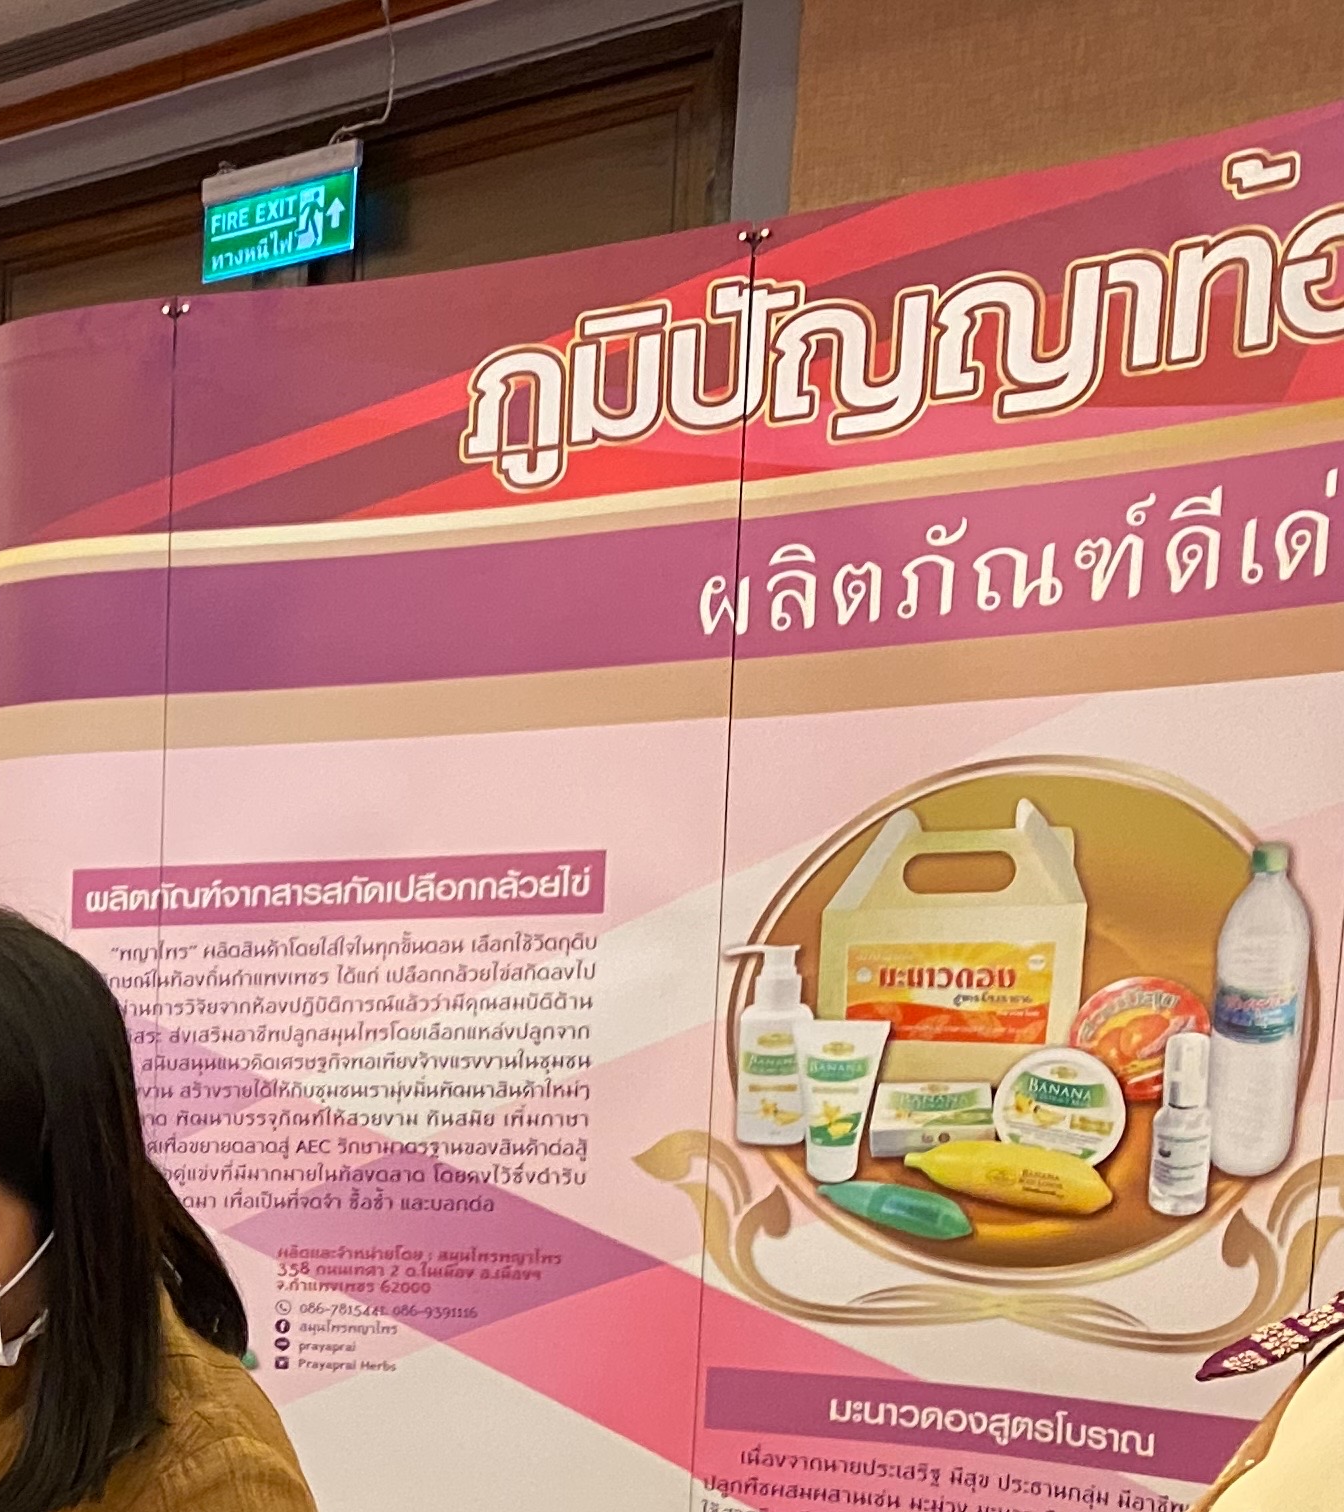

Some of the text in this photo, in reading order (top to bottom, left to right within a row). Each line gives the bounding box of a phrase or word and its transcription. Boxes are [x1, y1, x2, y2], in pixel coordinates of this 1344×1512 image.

[211, 194, 299, 235] FIRE EXIT
[211, 230, 294, 272] ทางหนีไฟ
[85, 863, 592, 913] ผลิตภัณฑ์จากสารสกัดเปลือกกล้วยไข่
[105, 964, 329, 989] กษณ์ในท้องถิ่นกำแพงเพชร
[878, 964, 1018, 990] มะนาวดอง
[1028, 1077, 1093, 1102] BANANA
[146, 1133, 290, 1159] ศเพื่อขยายตลาดสู่
[295, 1139, 331, 1155] AEC
[277, 1262, 310, 1277] 358
[379, 1280, 432, 1295] 62000
[828, 1398, 1155, 1458] มะนาวดองสูตรโบราณ
